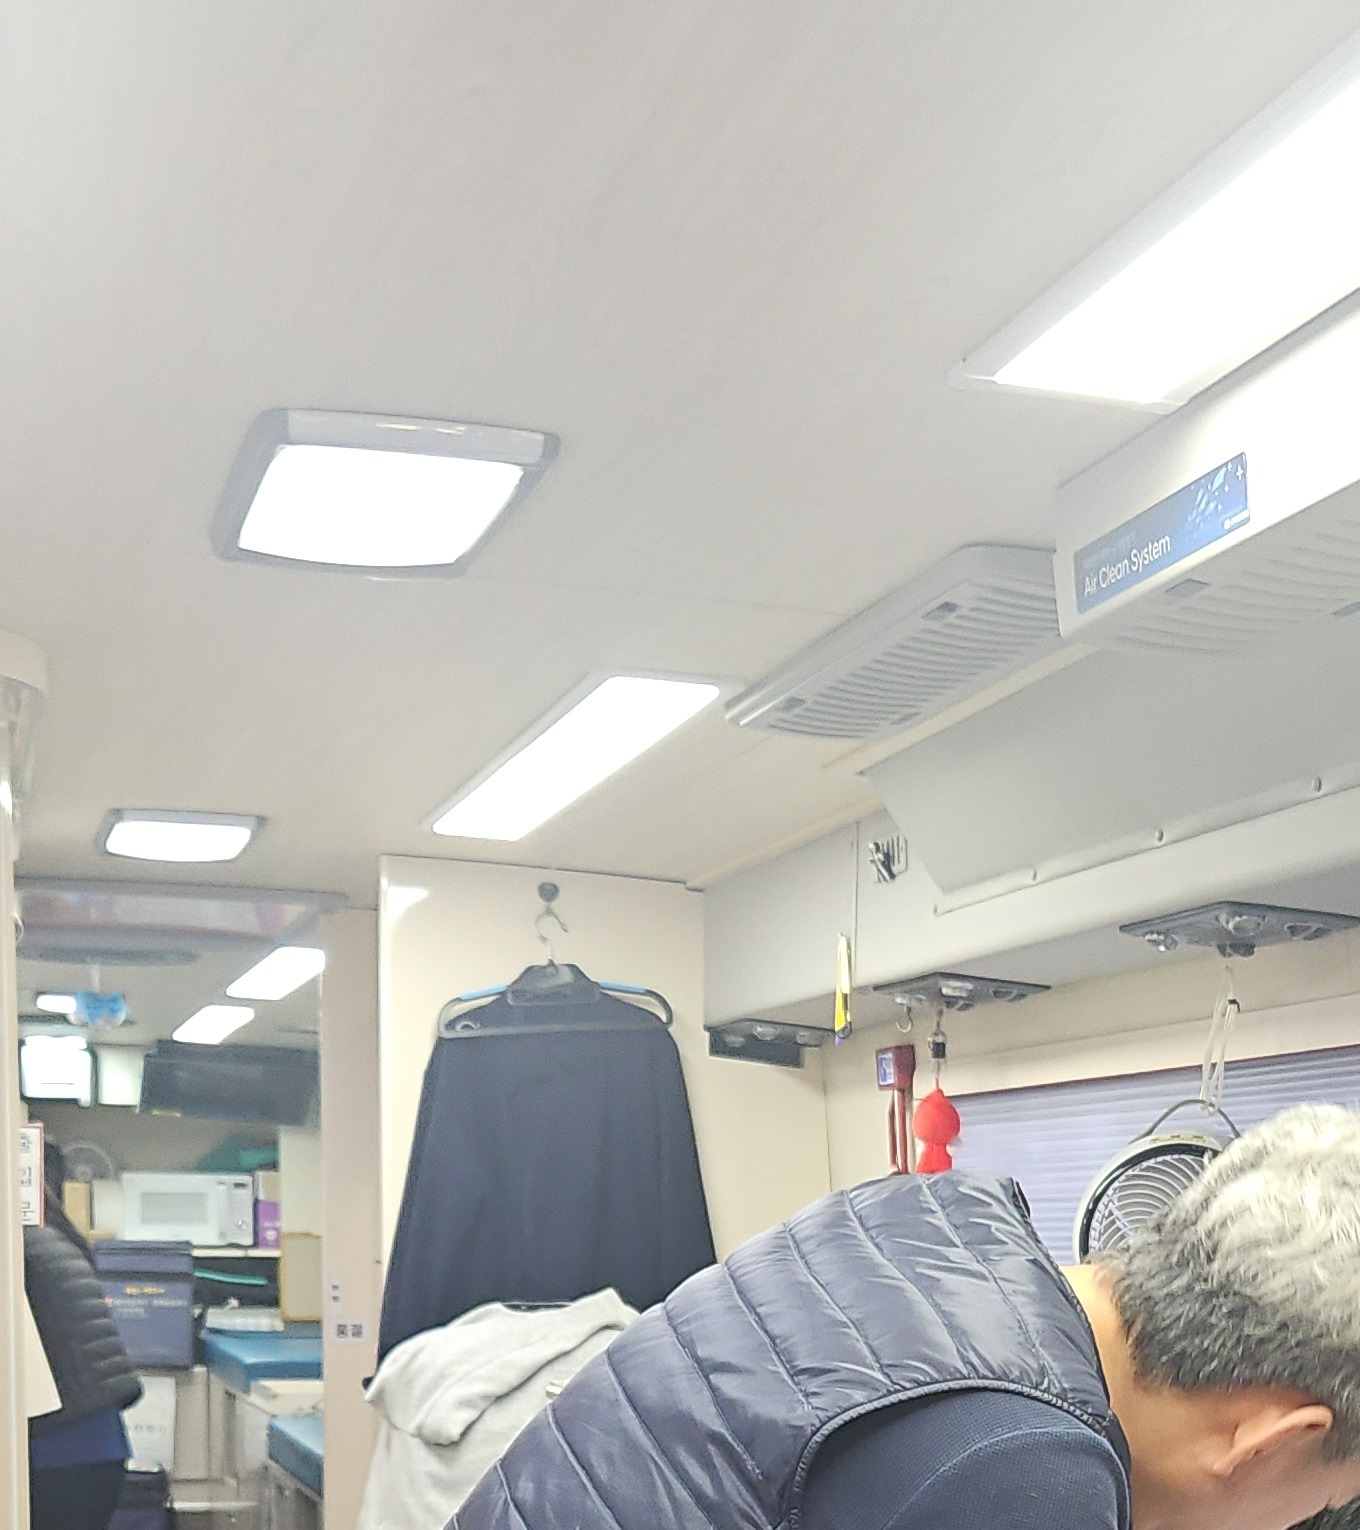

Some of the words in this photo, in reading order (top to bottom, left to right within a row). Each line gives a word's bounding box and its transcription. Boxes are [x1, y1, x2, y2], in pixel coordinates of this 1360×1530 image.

[1084, 576, 1097, 597] Air
[1099, 557, 1130, 589] Clean
[1131, 535, 1171, 573] System
